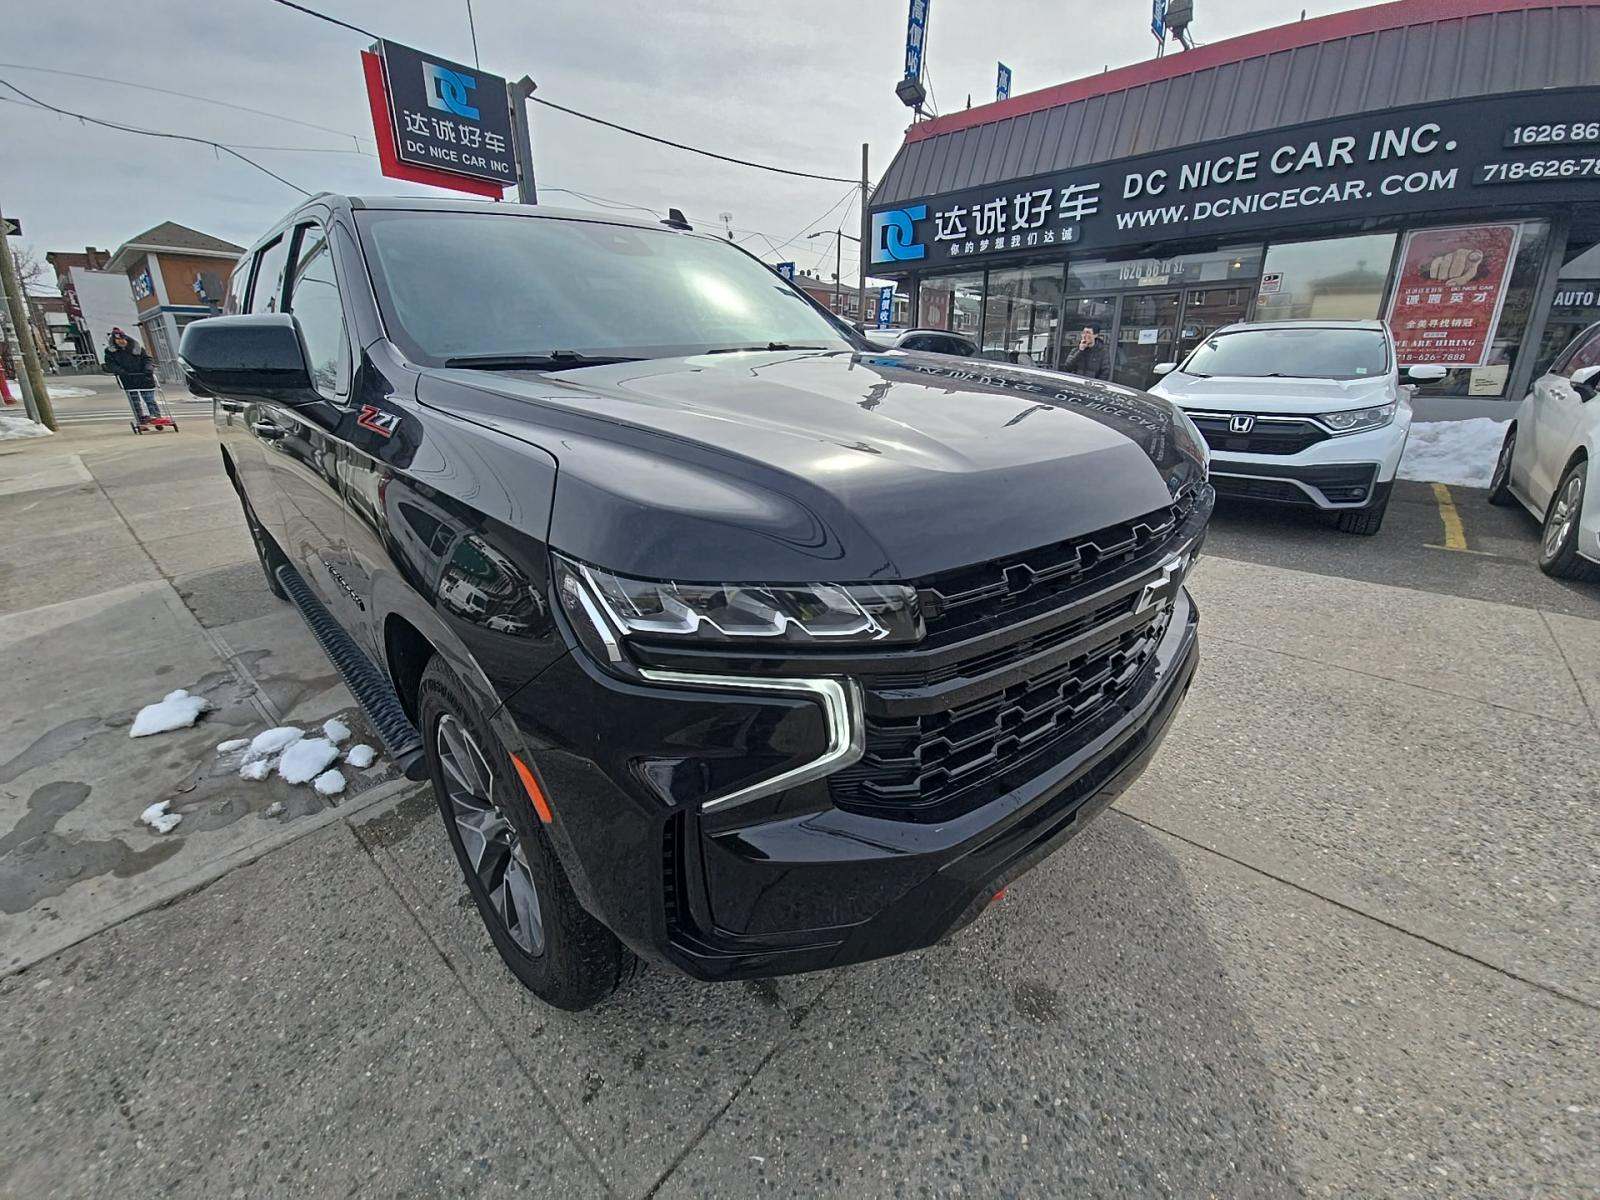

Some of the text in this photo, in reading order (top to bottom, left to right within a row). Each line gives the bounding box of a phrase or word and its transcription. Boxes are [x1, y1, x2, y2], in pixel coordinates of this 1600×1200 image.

[403, 110, 506, 154] 达诚好车
[1513, 122, 1600, 144] 1626 86
[406, 139, 510, 173] DC NICE CAR INC
[1122, 122, 1458, 200] DC NICE CAR INC.
[934, 182, 1101, 242] 达诚好车
[950, 227, 1073, 255] 你的梦想我们达诚
[1119, 262, 1142, 280] 1626
[1553, 291, 1594, 306] AUTO
[1435, 339, 1476, 347] HIRING
[357, 403, 402, 438] Z71
